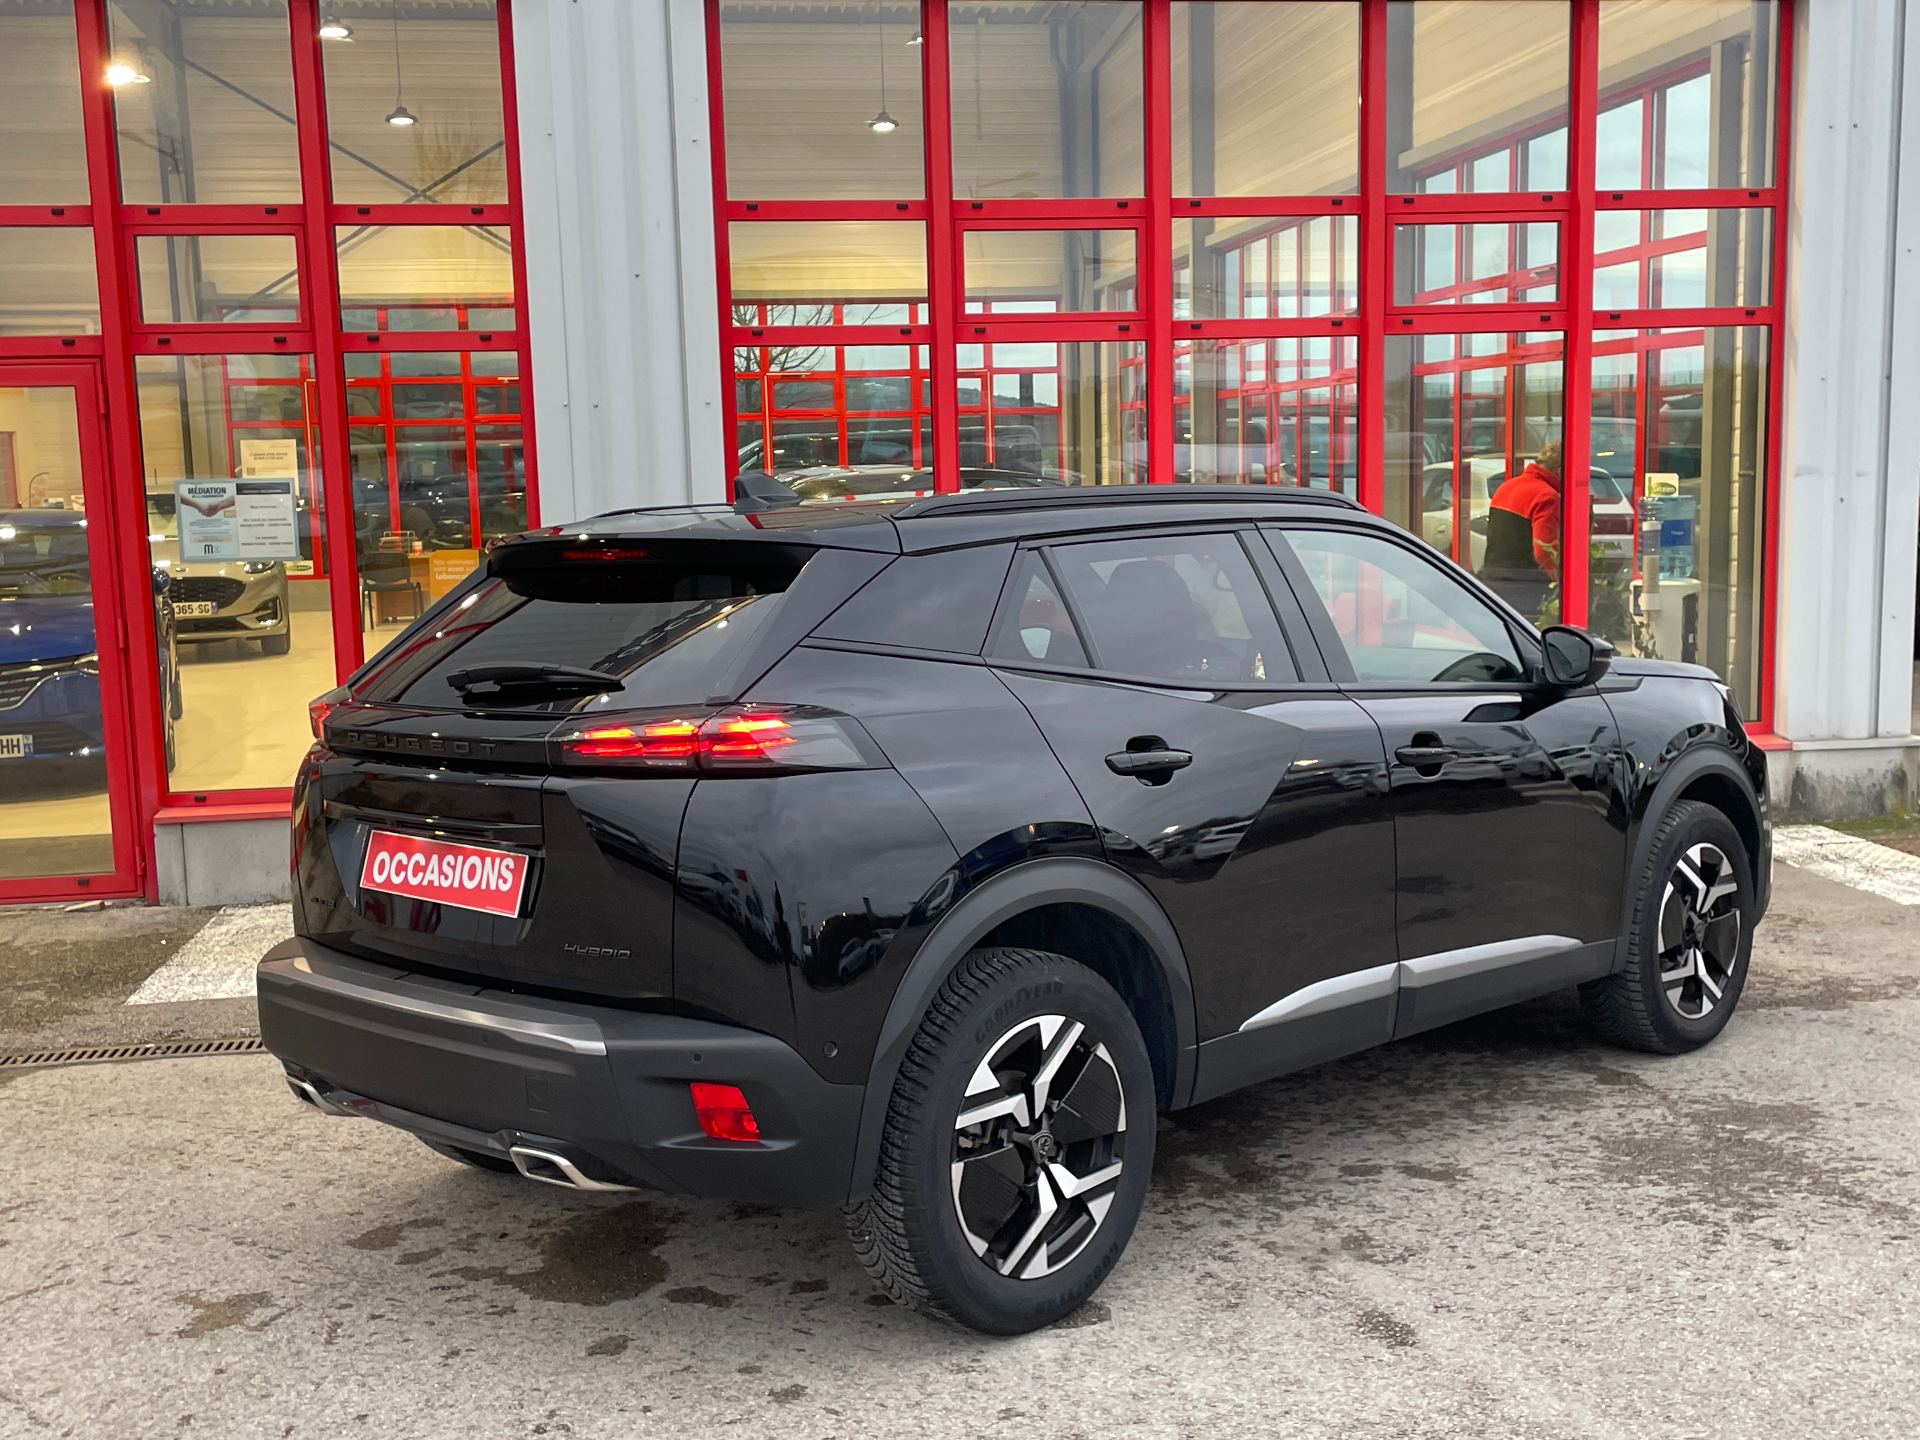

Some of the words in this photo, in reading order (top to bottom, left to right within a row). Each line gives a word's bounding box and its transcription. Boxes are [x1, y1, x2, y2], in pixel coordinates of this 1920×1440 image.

[188, 486, 227, 494] MÉDIATION
[346, 732, 498, 756] PEUGEOT
[372, 850, 516, 892] OCCASIONS
[563, 942, 632, 960] HYBRID
[975, 980, 1064, 1044] GOODYEAR
